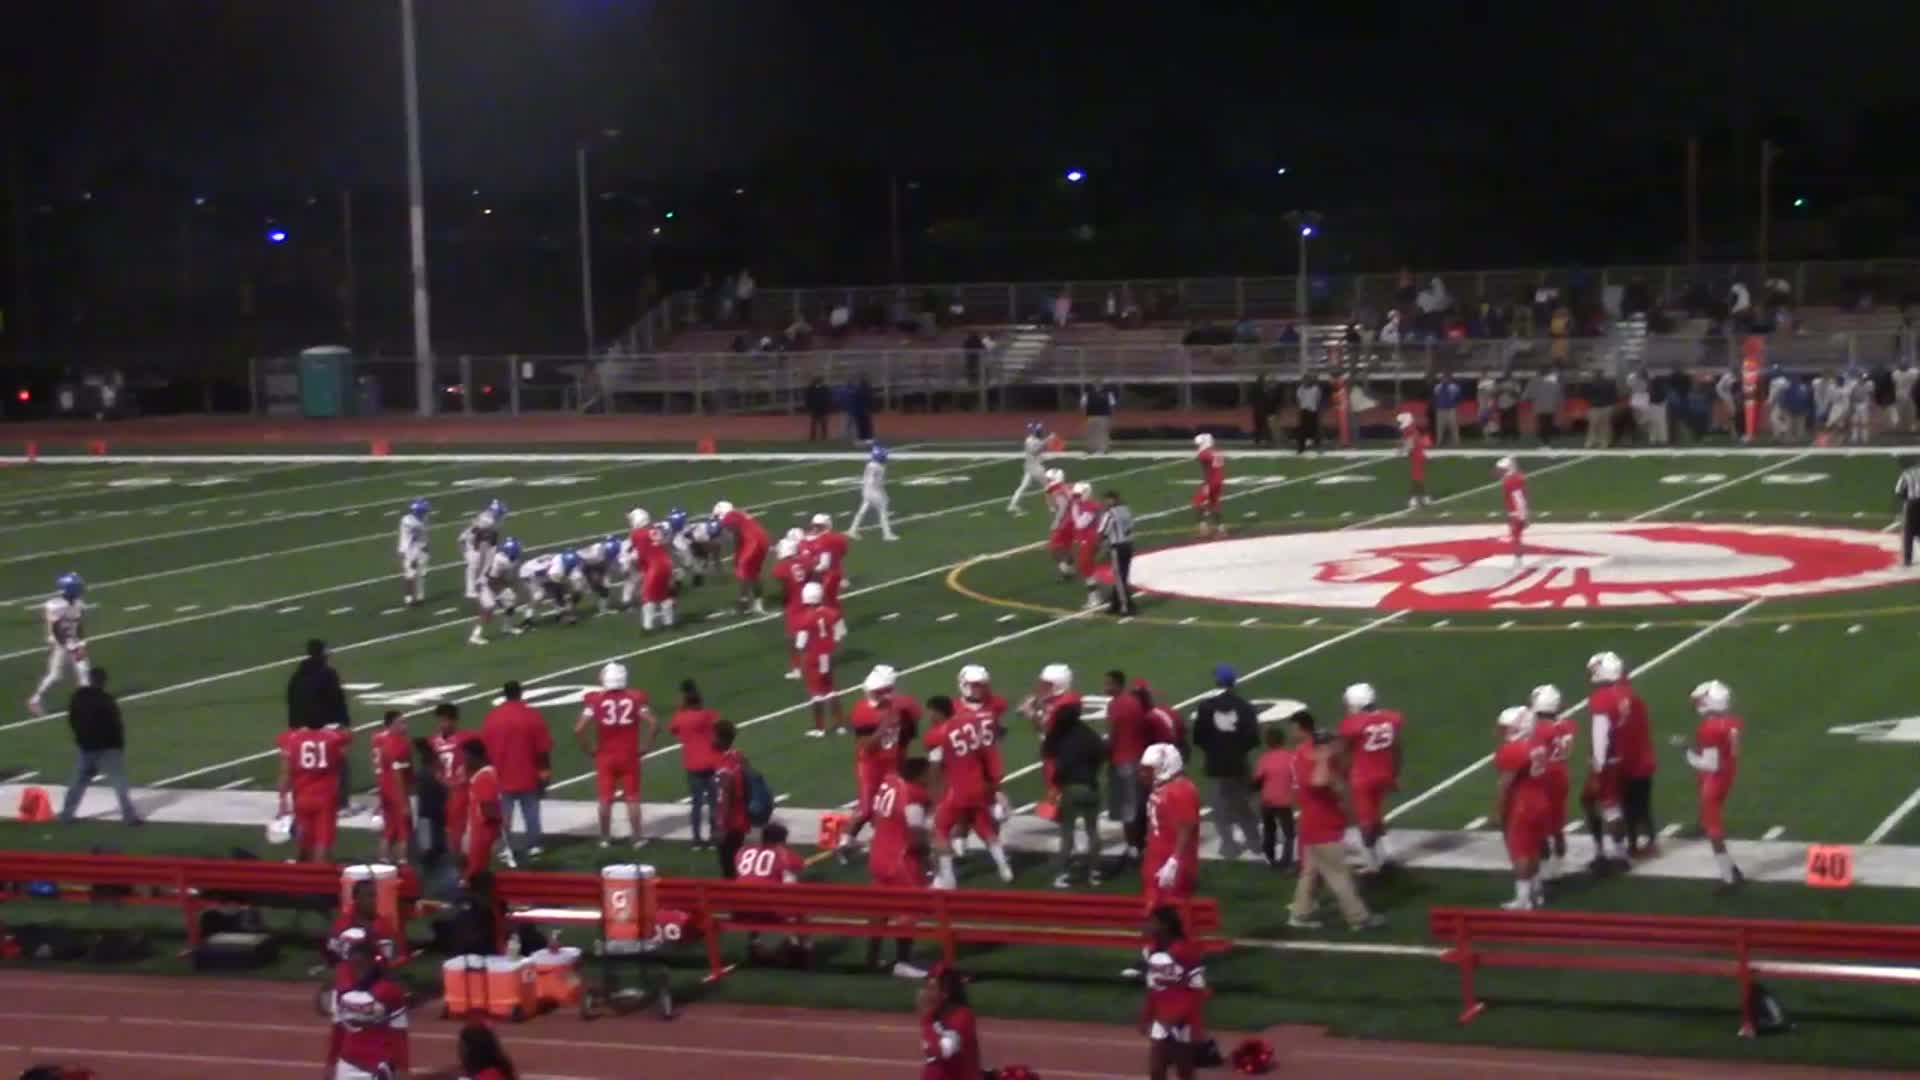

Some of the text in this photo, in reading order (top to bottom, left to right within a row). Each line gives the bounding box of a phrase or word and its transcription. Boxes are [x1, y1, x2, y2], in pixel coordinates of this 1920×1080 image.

[600, 698, 634, 725] 32
[300, 740, 328, 768] 61
[737, 848, 776, 876] 80
[1810, 853, 1846, 880] 40
